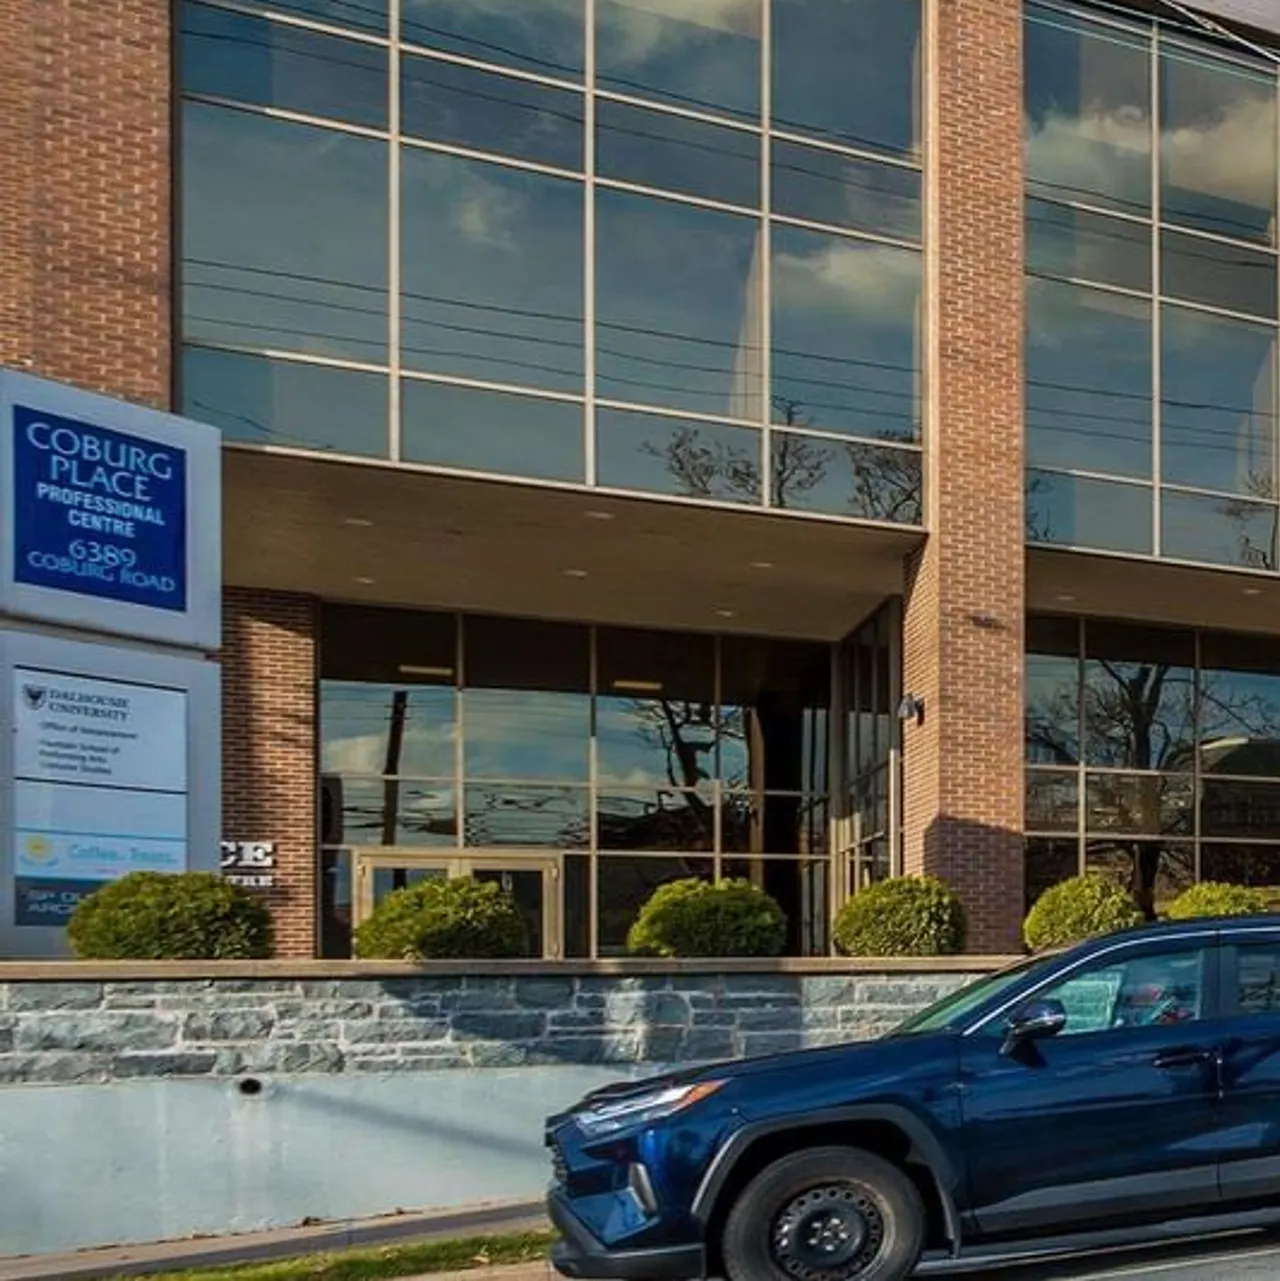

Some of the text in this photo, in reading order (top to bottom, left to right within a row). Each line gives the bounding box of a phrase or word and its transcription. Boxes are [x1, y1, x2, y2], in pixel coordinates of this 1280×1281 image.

[26, 422, 172, 479] COBURG
[51, 455, 152, 501] PLACE
[36, 482, 166, 526] PROFESSIONAL
[68, 509, 136, 538] CENTRE
[27, 551, 176, 593] COBURG ROAD
[69, 539, 137, 568] 6389
[49, 703, 128, 721] UNIVERSITY
